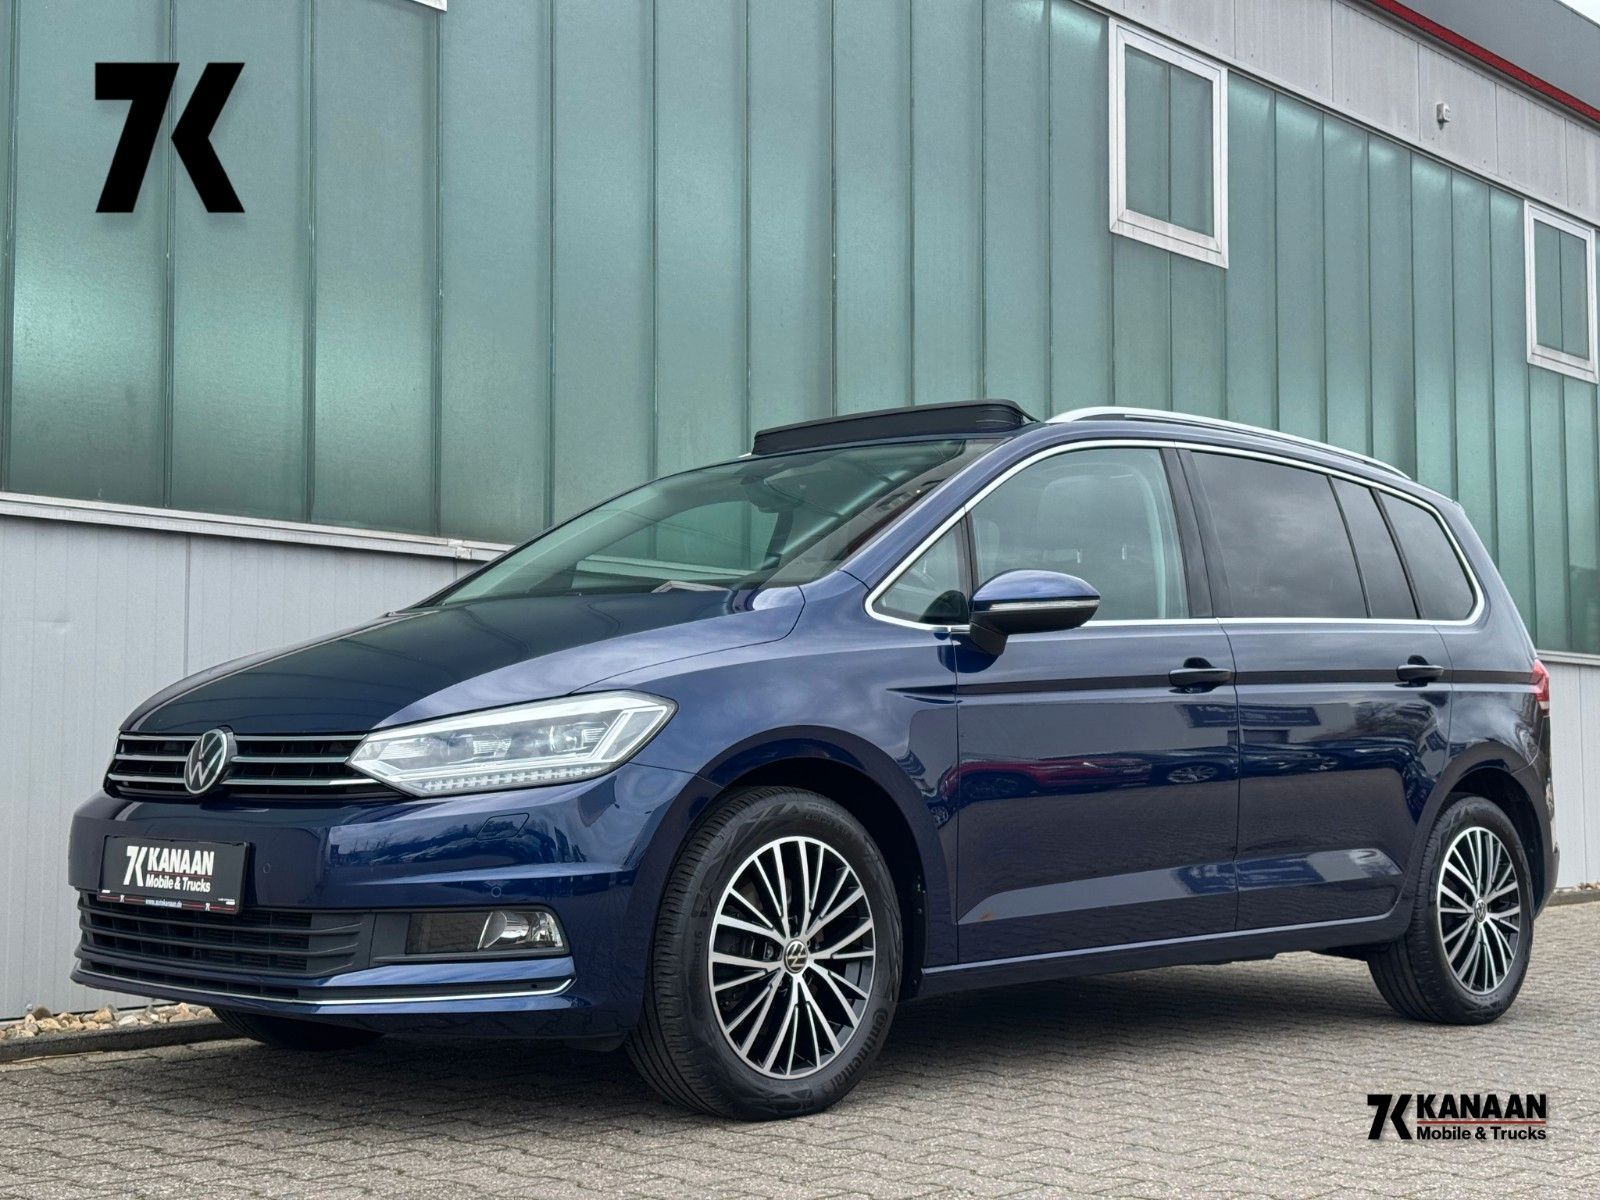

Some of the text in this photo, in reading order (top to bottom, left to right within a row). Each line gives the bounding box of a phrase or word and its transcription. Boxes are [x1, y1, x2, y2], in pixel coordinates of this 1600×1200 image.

[147, 847, 215, 876] KANAAN
[145, 873, 211, 893] Mobile & Trucks
